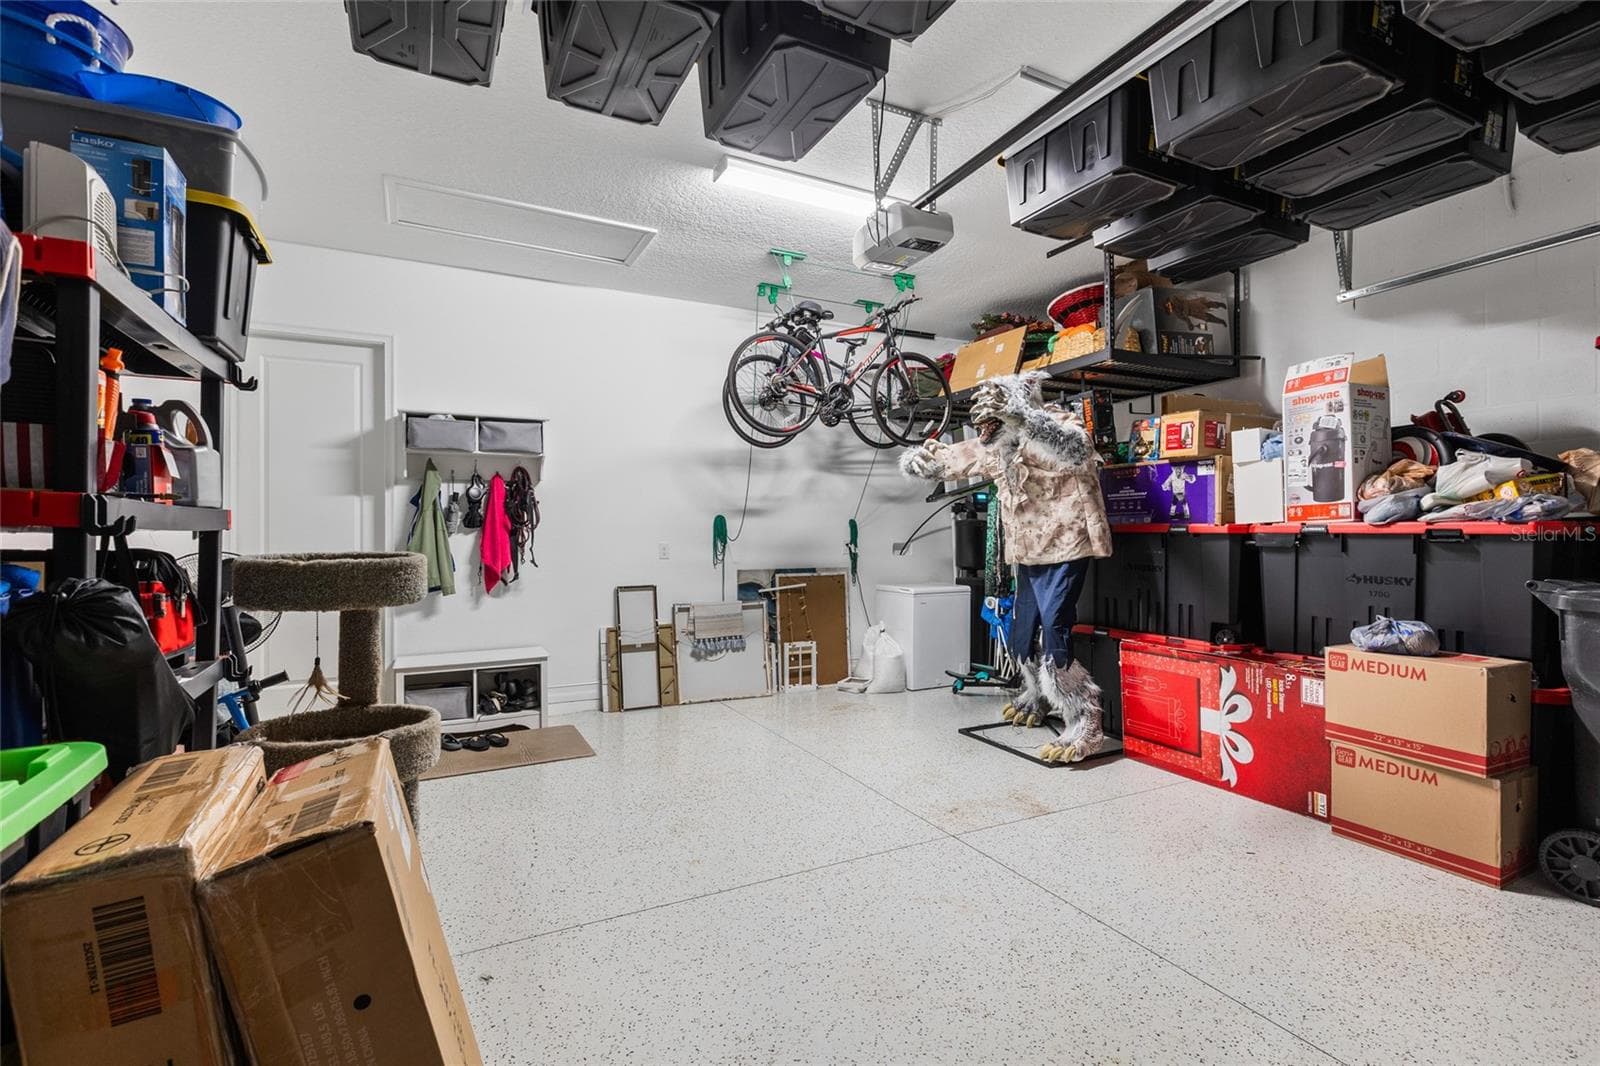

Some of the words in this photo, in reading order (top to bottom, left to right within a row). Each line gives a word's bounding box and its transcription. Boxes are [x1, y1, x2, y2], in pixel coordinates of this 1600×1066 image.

[71, 133, 115, 148] Lasko
[1363, 575, 1415, 587] HUSKY
[1350, 658, 1427, 681] MEDIUM
[1358, 755, 1438, 786] MEDIUM
